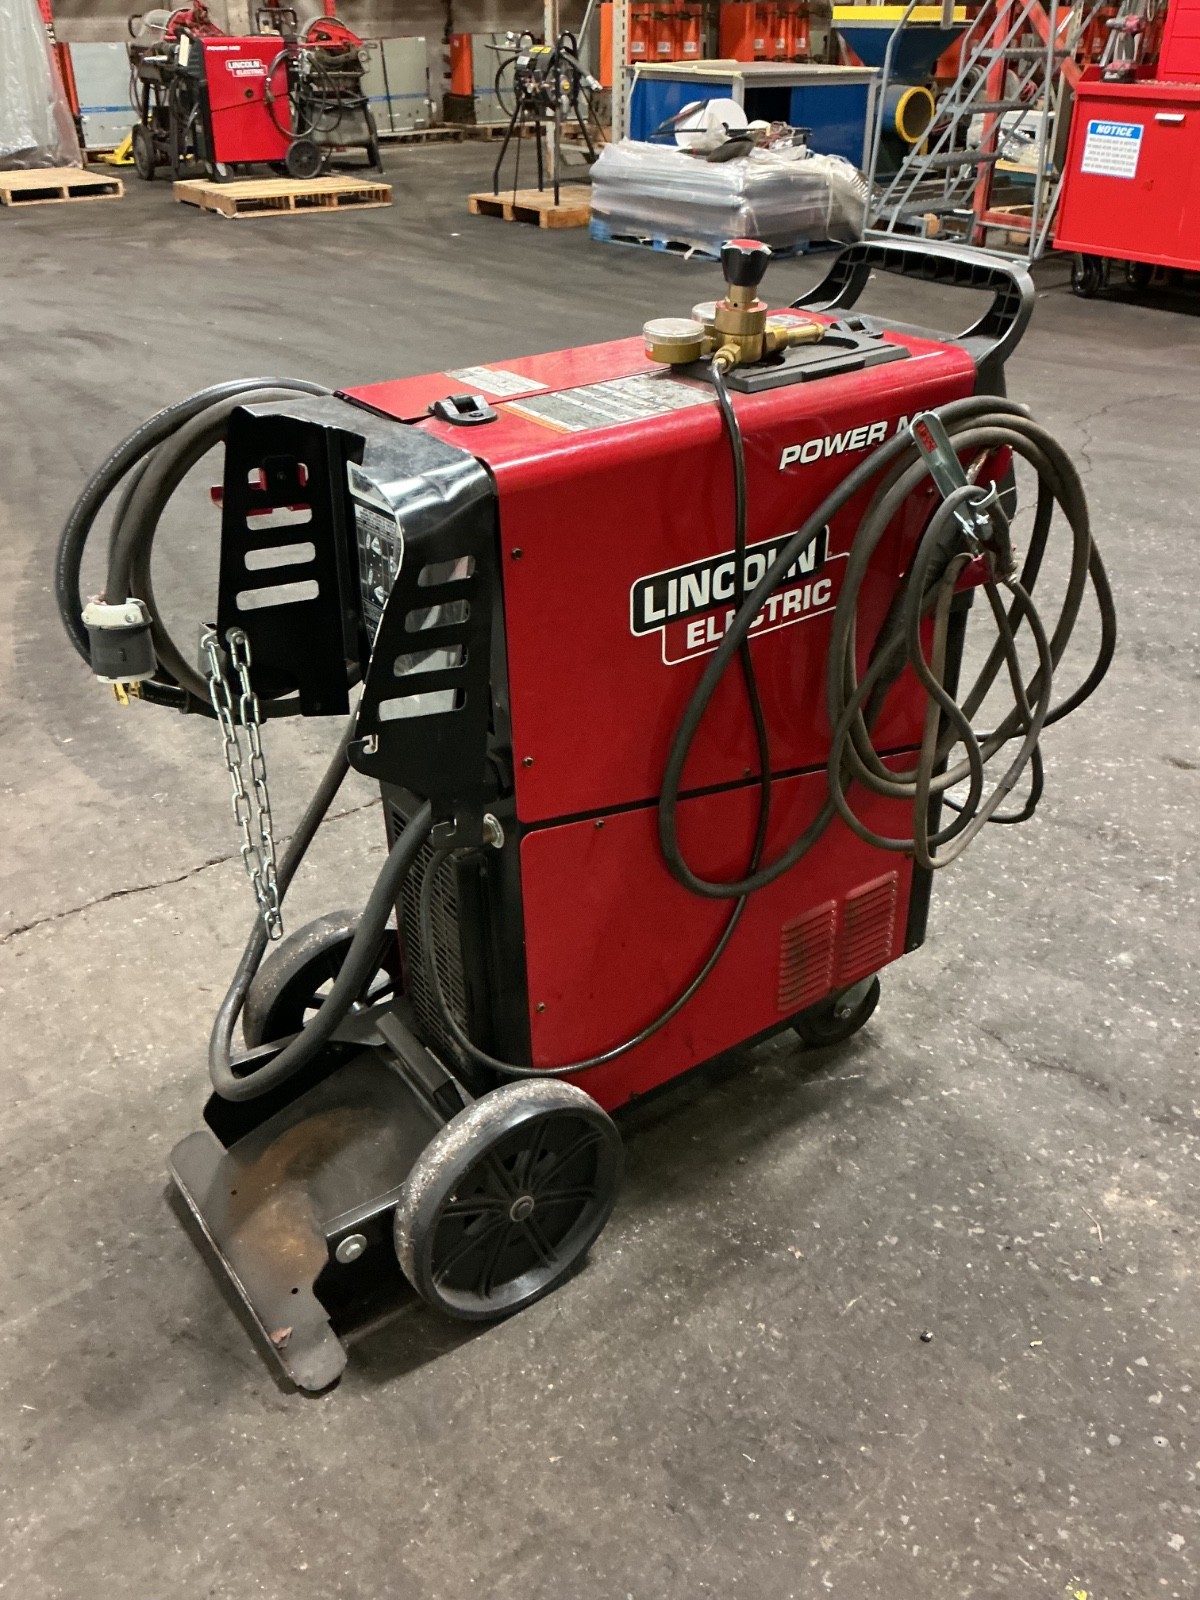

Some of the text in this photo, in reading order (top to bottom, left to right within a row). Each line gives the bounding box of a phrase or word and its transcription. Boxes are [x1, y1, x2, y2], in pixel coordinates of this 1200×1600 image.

[228, 61, 260, 69] LINCOLN
[1096, 124, 1135, 137] NOTICE
[778, 420, 888, 471] POWER
